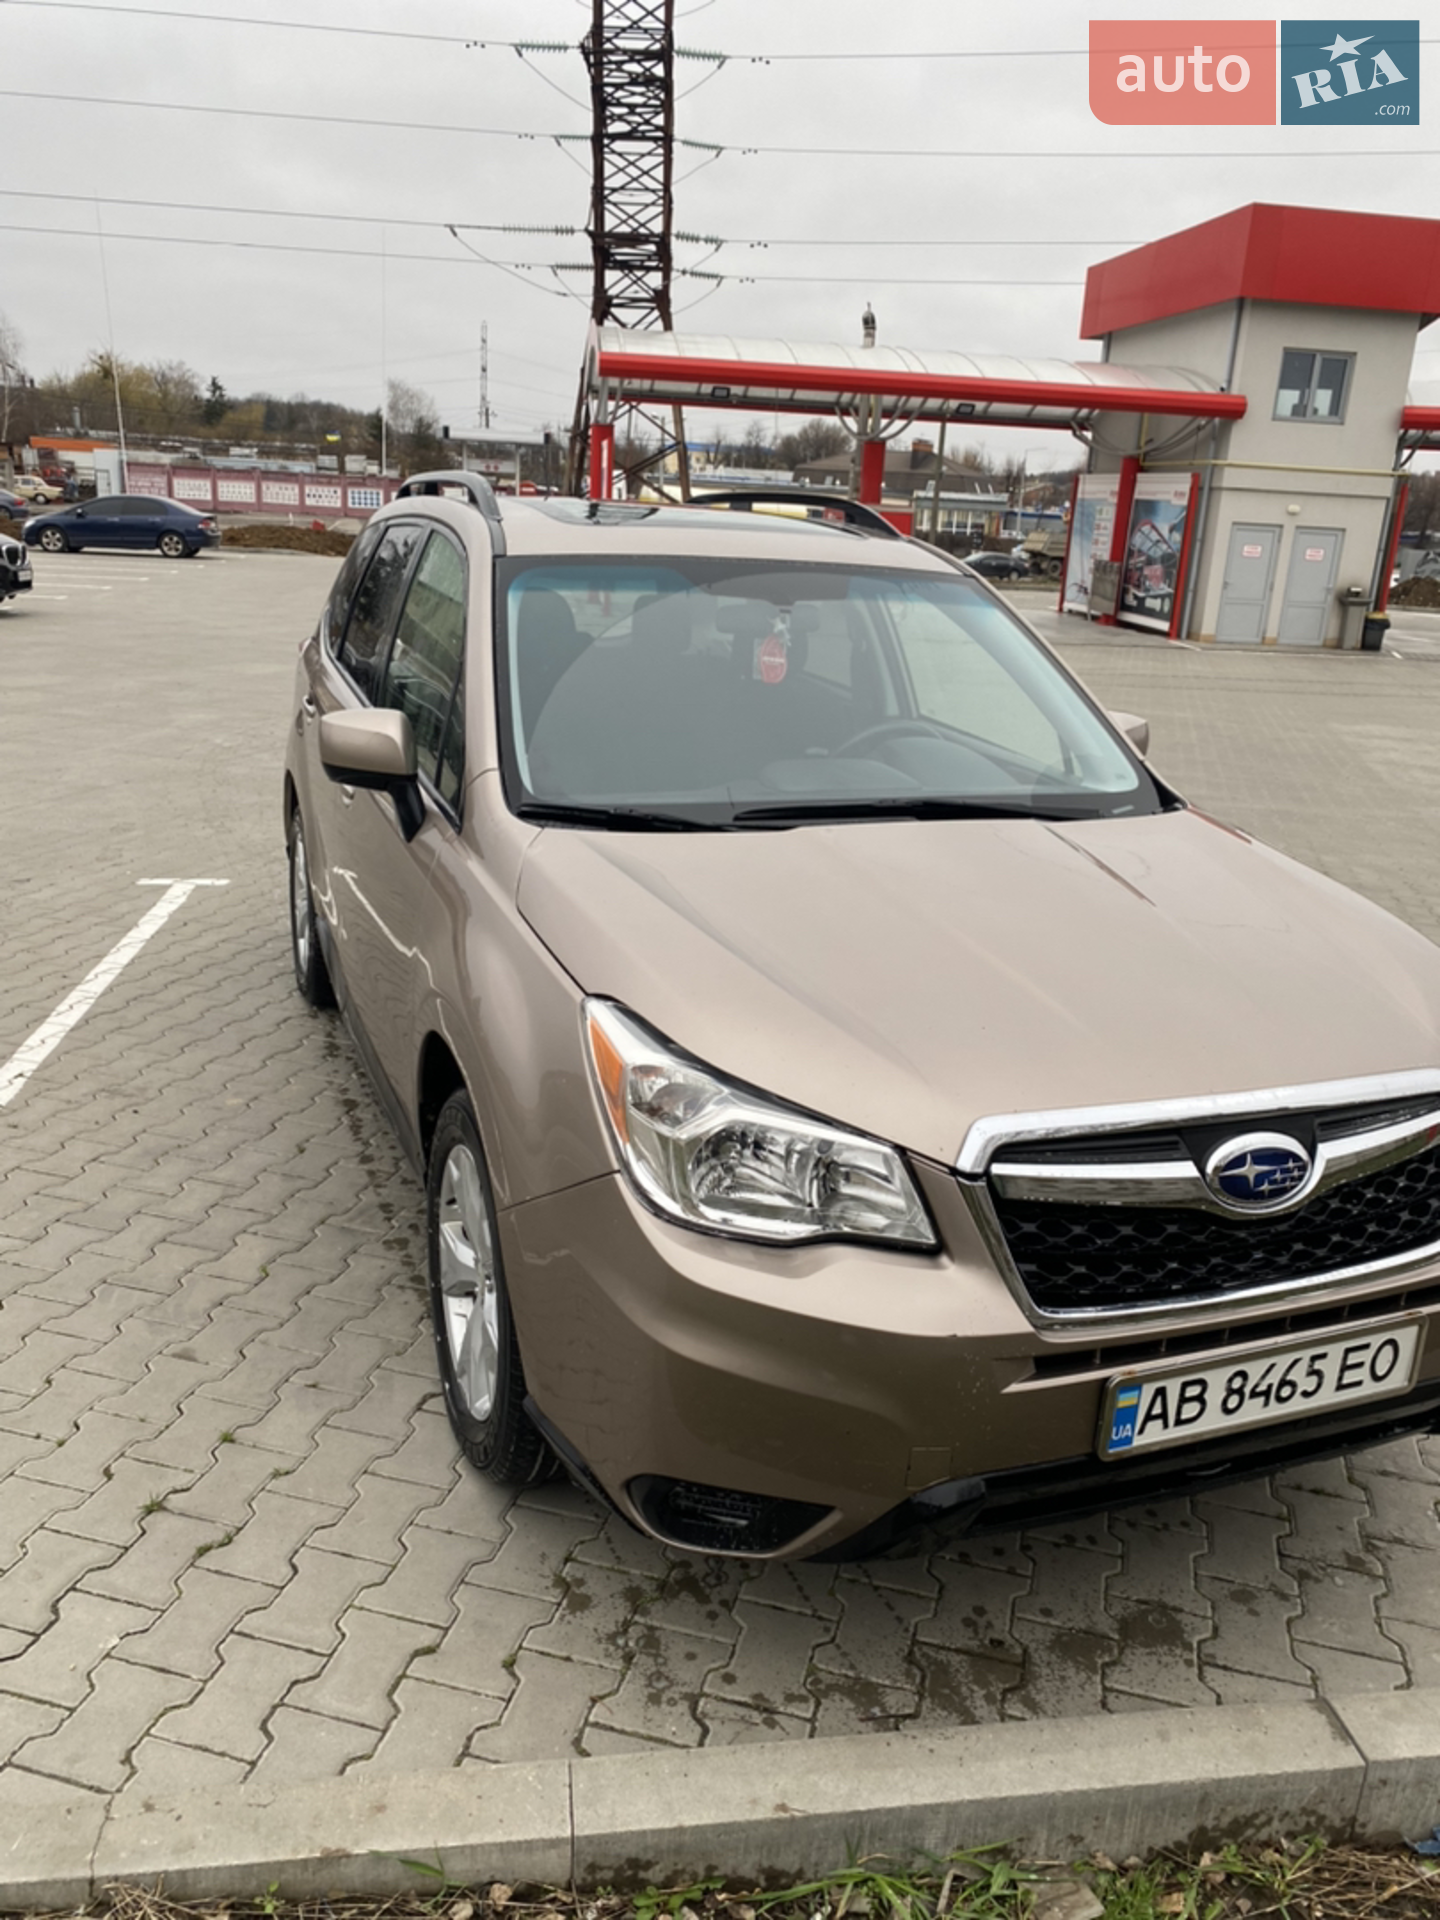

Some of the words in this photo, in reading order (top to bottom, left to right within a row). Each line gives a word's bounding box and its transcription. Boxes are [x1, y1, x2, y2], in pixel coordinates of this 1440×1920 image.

[1137, 1377, 1209, 1436] AB
[1221, 1352, 1329, 1416] 8465
[1335, 1337, 1400, 1393] EO
[1111, 1425, 1133, 1441] UA
